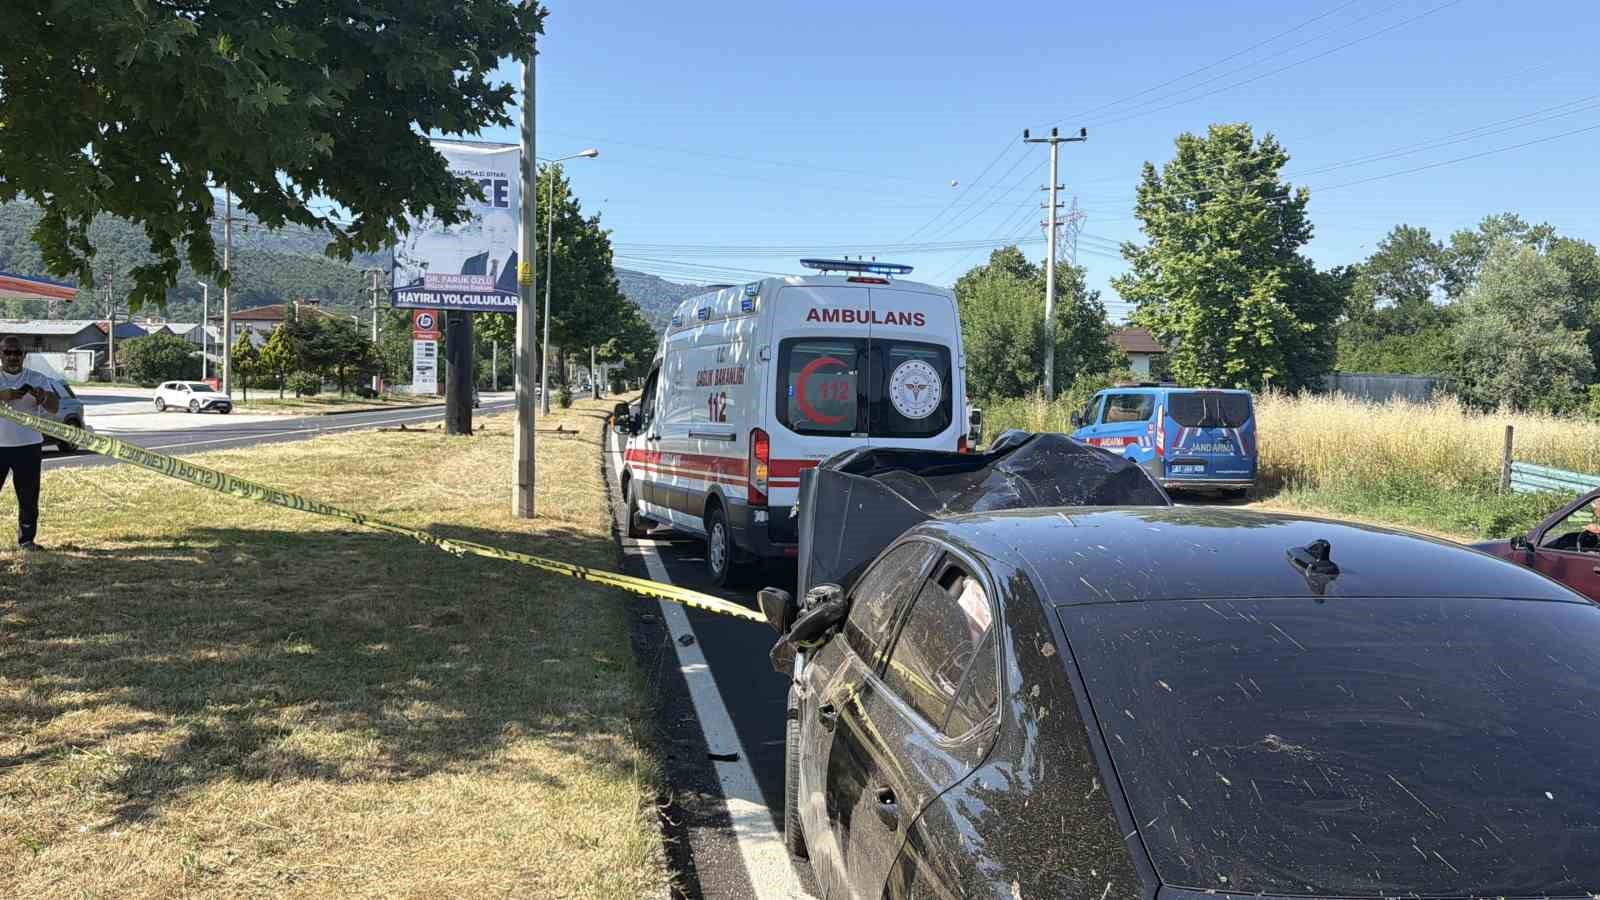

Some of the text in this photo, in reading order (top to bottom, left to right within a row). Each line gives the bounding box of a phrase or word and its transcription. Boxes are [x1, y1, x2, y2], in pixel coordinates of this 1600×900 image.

[397, 292, 518, 306] HAYIRLI YOLCULUKLAR
[806, 307, 926, 327] AMBULANS
[819, 381, 849, 401] 112
[708, 391, 727, 423] 112
[1190, 442, 1235, 452] JANDARMA
